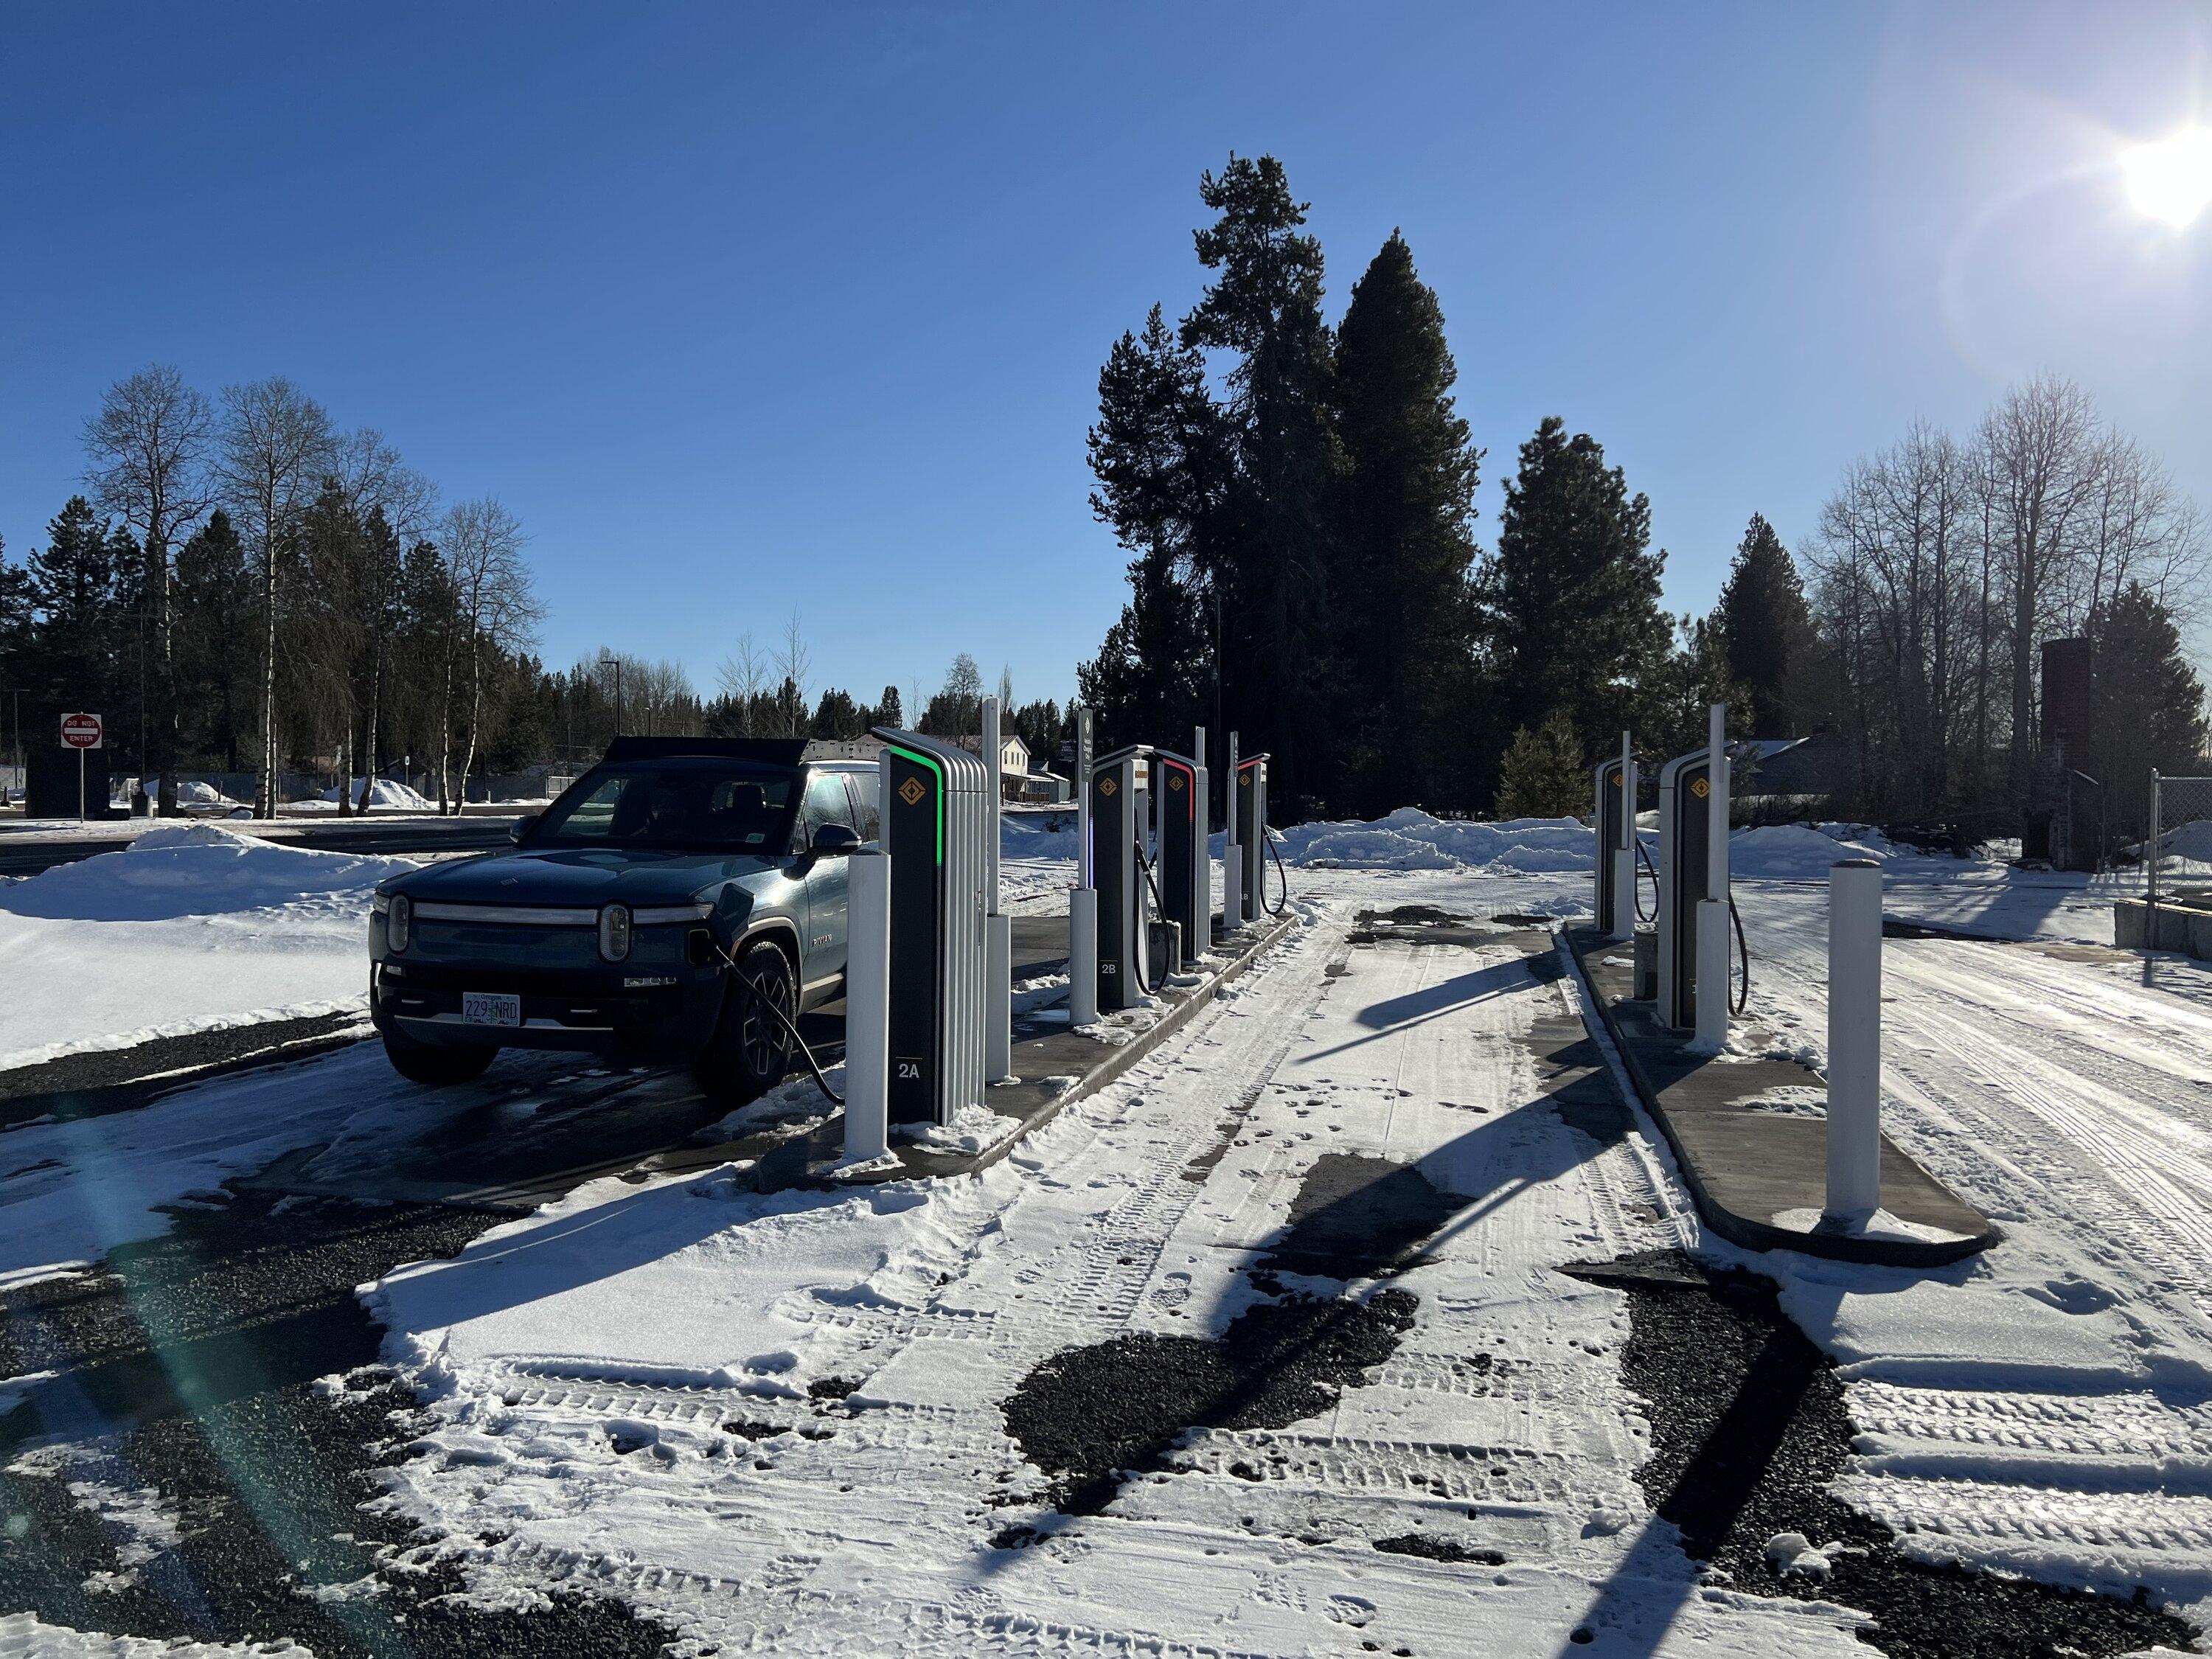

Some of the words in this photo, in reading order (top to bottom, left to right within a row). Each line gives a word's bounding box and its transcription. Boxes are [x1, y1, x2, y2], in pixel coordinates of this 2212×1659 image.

[812, 933, 832, 947] RIVIAN
[1102, 964, 1116, 974] 2B
[466, 1000, 487, 1017] 229
[495, 1002, 517, 1019] NRD
[899, 1063, 919, 1078] 2A
